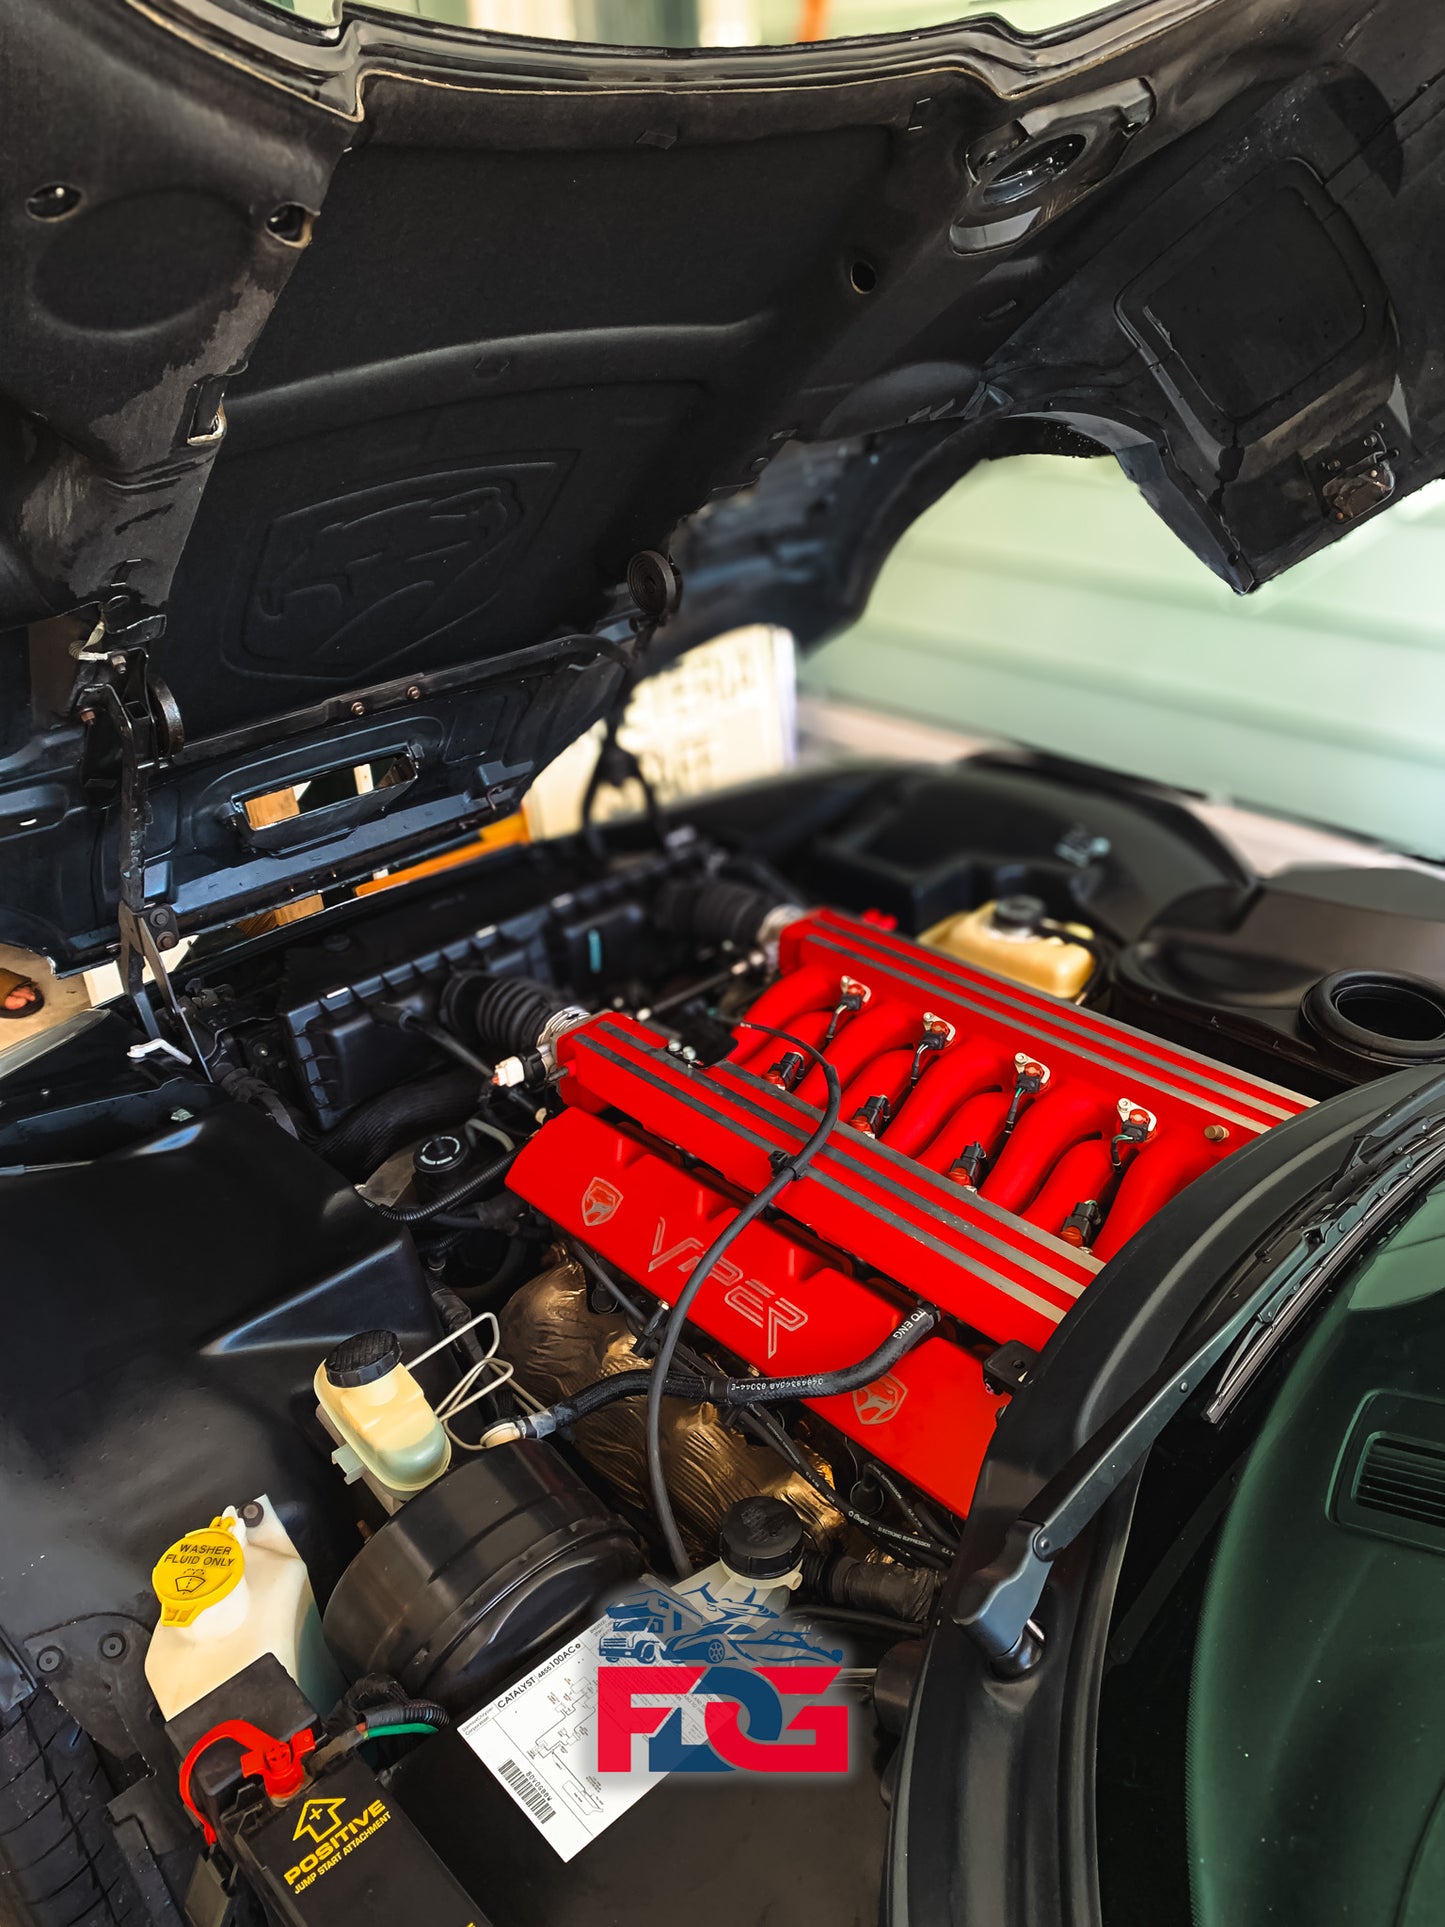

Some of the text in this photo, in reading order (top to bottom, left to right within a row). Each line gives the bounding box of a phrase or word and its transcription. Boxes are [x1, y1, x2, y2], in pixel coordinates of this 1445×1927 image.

[893, 1309, 926, 1339] TO ENG
[164, 1554, 235, 1567] FLUID ONLY
[180, 1544, 232, 1555] WASHER
[497, 1676, 536, 1709] CATALYST
[284, 1799, 386, 1886] POSITIVE
[294, 1811, 391, 1895] JUMP START ATTACHMENT
